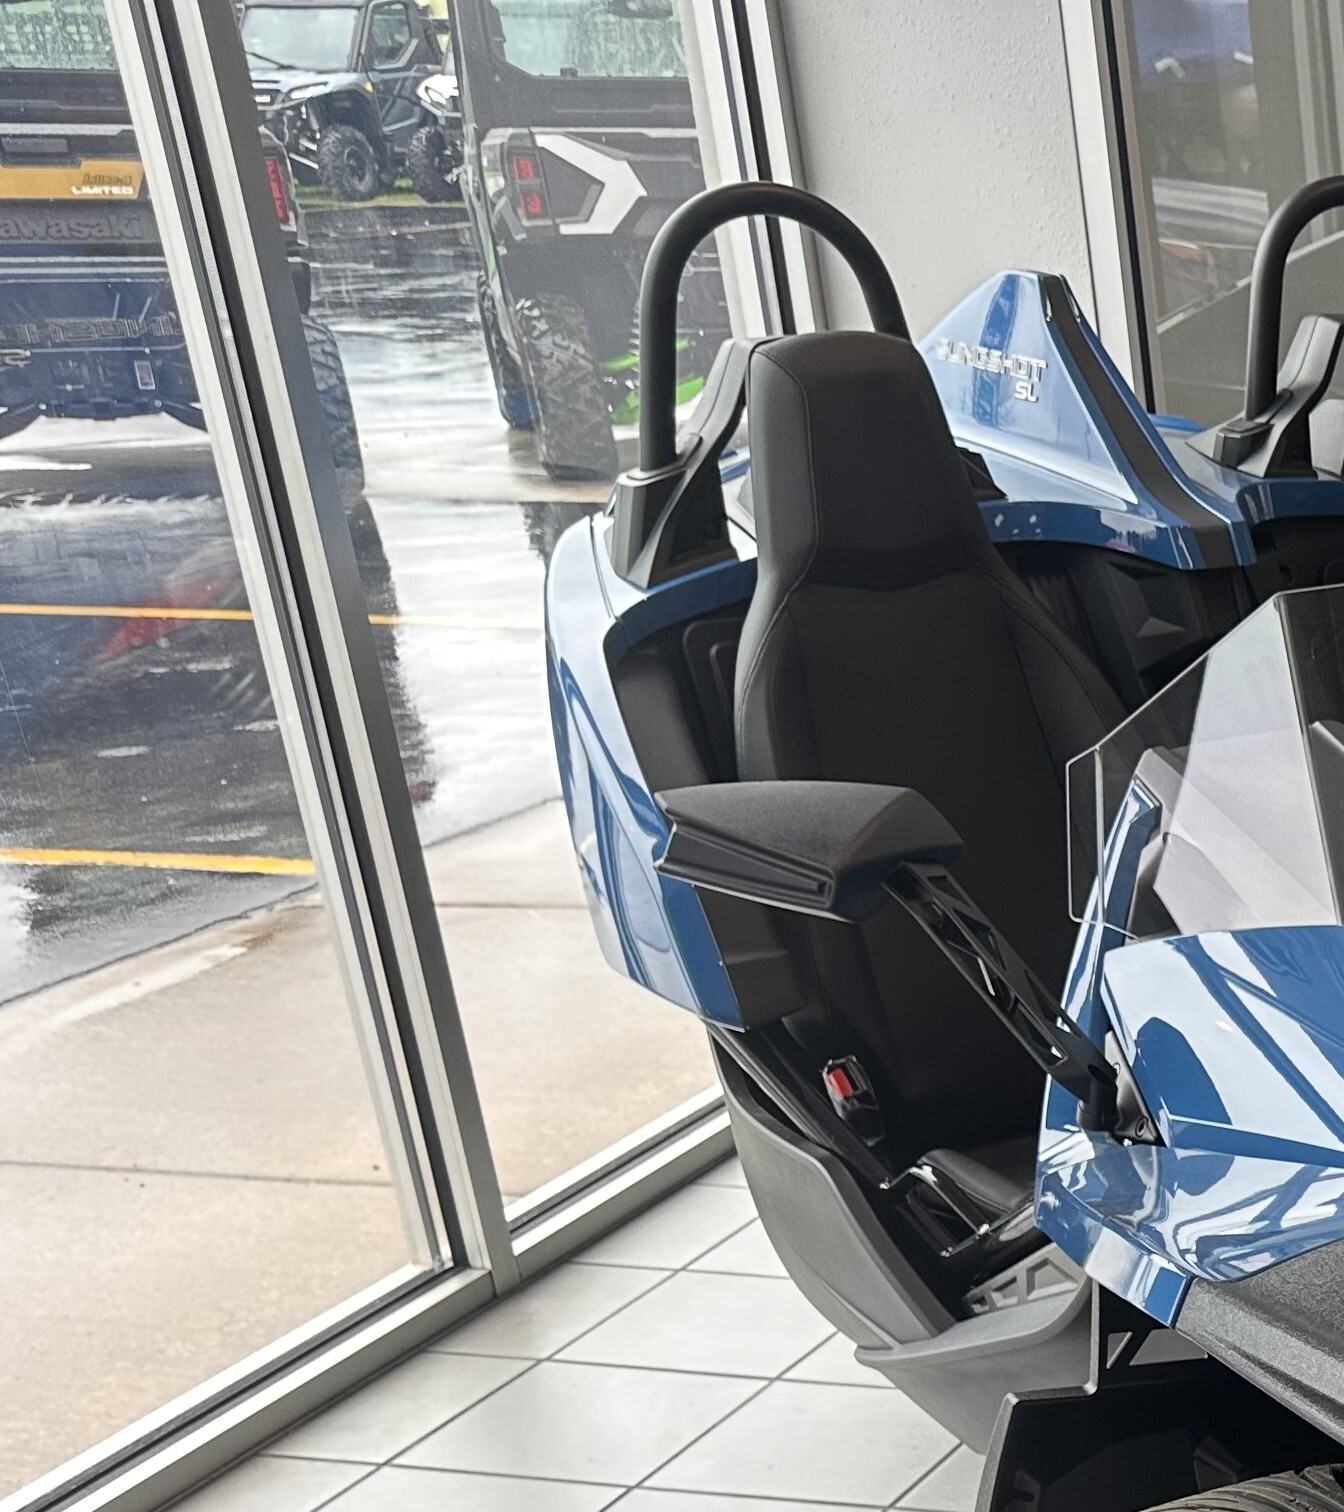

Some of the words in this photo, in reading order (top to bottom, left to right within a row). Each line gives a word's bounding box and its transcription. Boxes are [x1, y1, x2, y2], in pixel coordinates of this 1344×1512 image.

[70, 184, 134, 195] LIMITED
[0, 213, 143, 240] awasaki
[936, 338, 1048, 383] SLINGSHOT
[1014, 381, 1038, 402] SL
